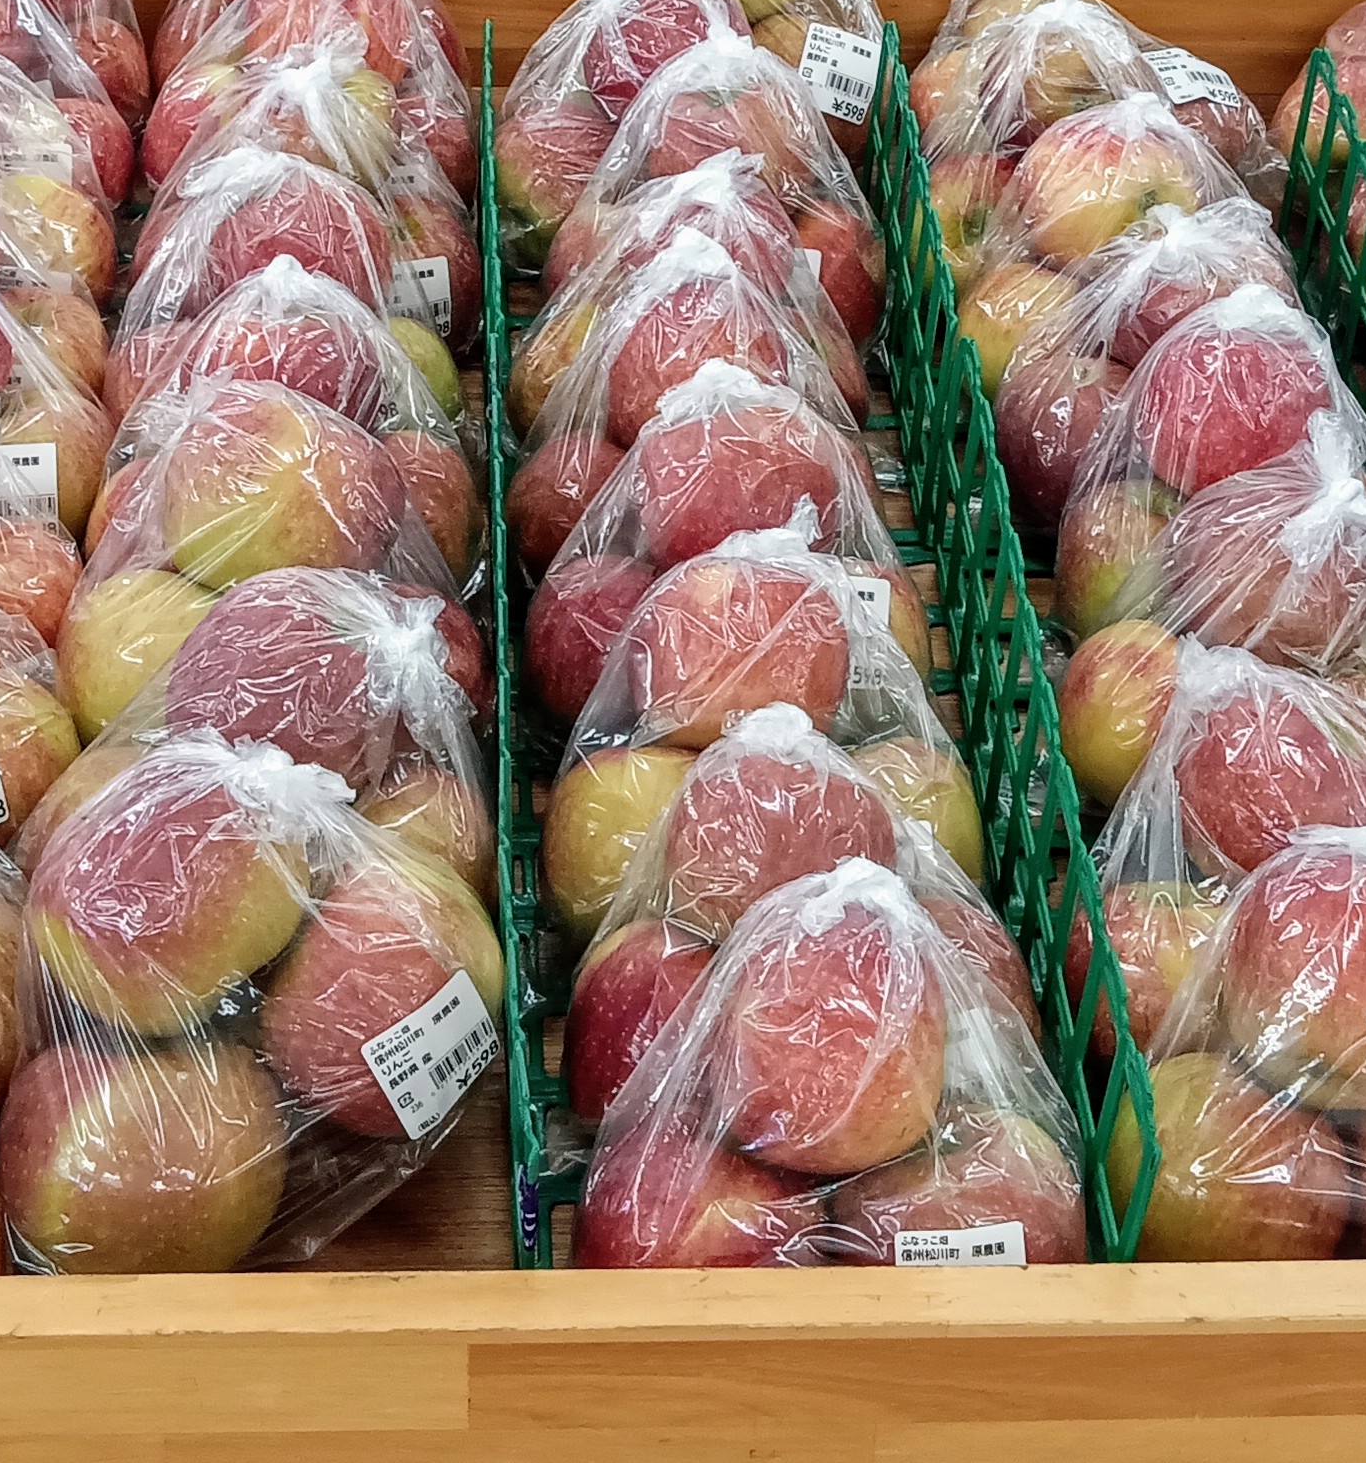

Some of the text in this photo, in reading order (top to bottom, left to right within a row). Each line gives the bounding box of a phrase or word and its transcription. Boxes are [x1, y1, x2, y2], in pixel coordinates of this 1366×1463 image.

[832, 98, 864, 121] ¥598
[374, 1027, 425, 1067] 信州松川町
[382, 1050, 414, 1076] りんご
[389, 1052, 433, 1090] 長野県 産
[456, 1040, 499, 1090] ¥598
[411, 1101, 423, 1113] 236
[901, 1236, 948, 1245] ふなっこ畑
[901, 1242, 1005, 1261] 信州松川町 原農園
